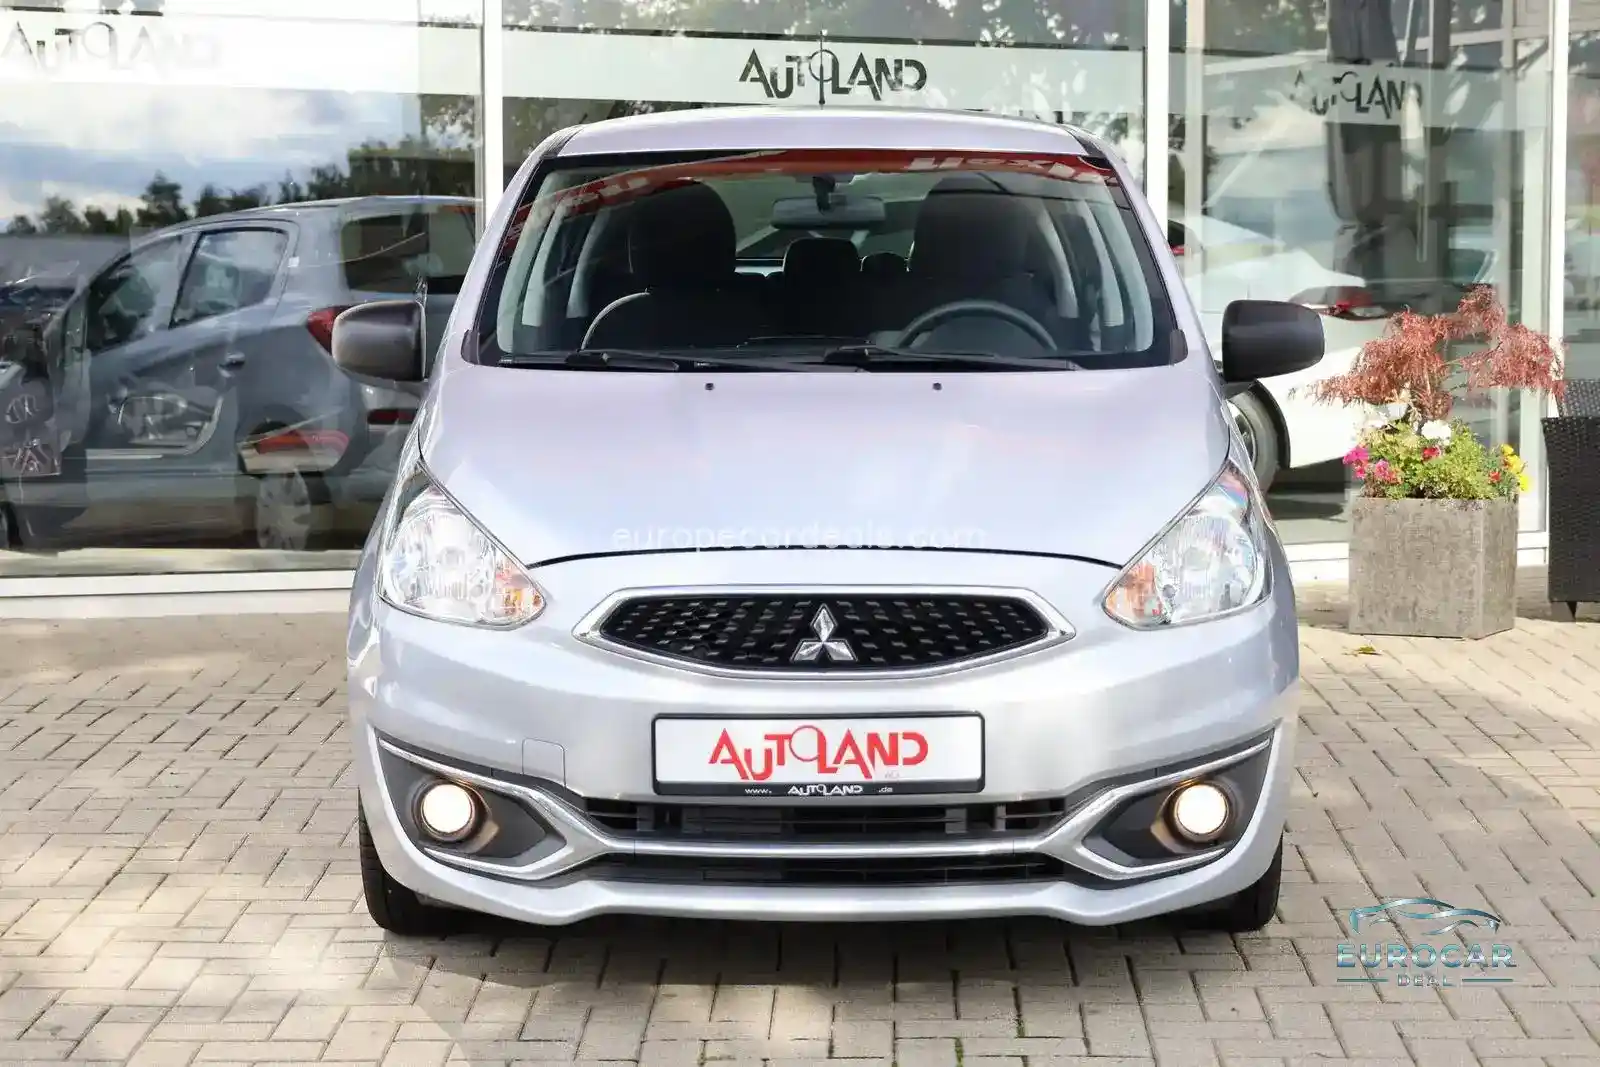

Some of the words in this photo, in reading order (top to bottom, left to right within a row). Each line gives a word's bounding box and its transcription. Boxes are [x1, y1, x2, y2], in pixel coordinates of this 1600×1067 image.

[739, 48, 927, 101] AUTOLAND
[708, 725, 929, 781] AUTOLAND
[788, 784, 863, 796] AUTOLAND
[878, 785, 894, 793] .de
